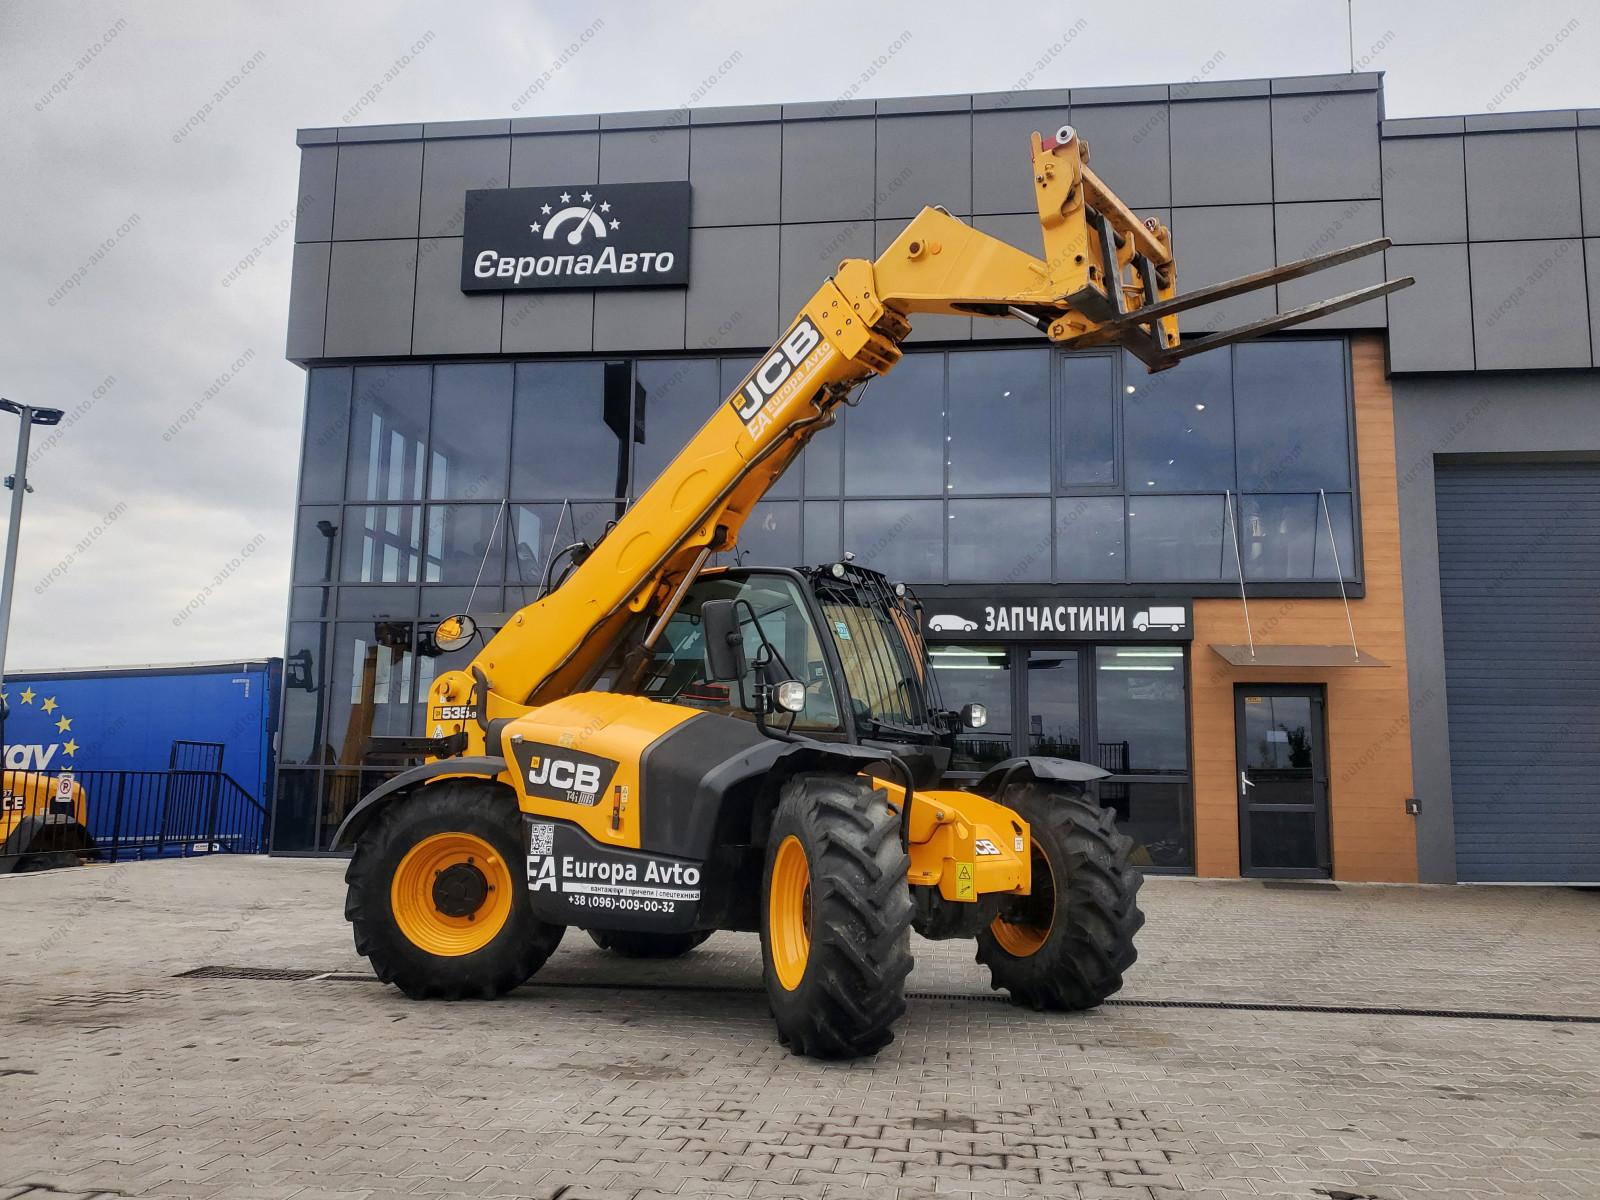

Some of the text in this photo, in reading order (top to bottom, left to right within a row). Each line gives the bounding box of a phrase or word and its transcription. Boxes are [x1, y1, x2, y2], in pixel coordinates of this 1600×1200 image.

[474, 246, 675, 284] ЄвропаАвто
[739, 321, 820, 420] JCB
[764, 371, 805, 411] Europa
[804, 342, 831, 372] Avto
[984, 606, 1125, 633] ЗАПЧАСТИНИ
[528, 758, 600, 794] JCB
[976, 839, 1002, 855] CB
[527, 855, 700, 892] EA Europa Avto
[568, 895, 675, 914] +38 (096)-009-00-32
